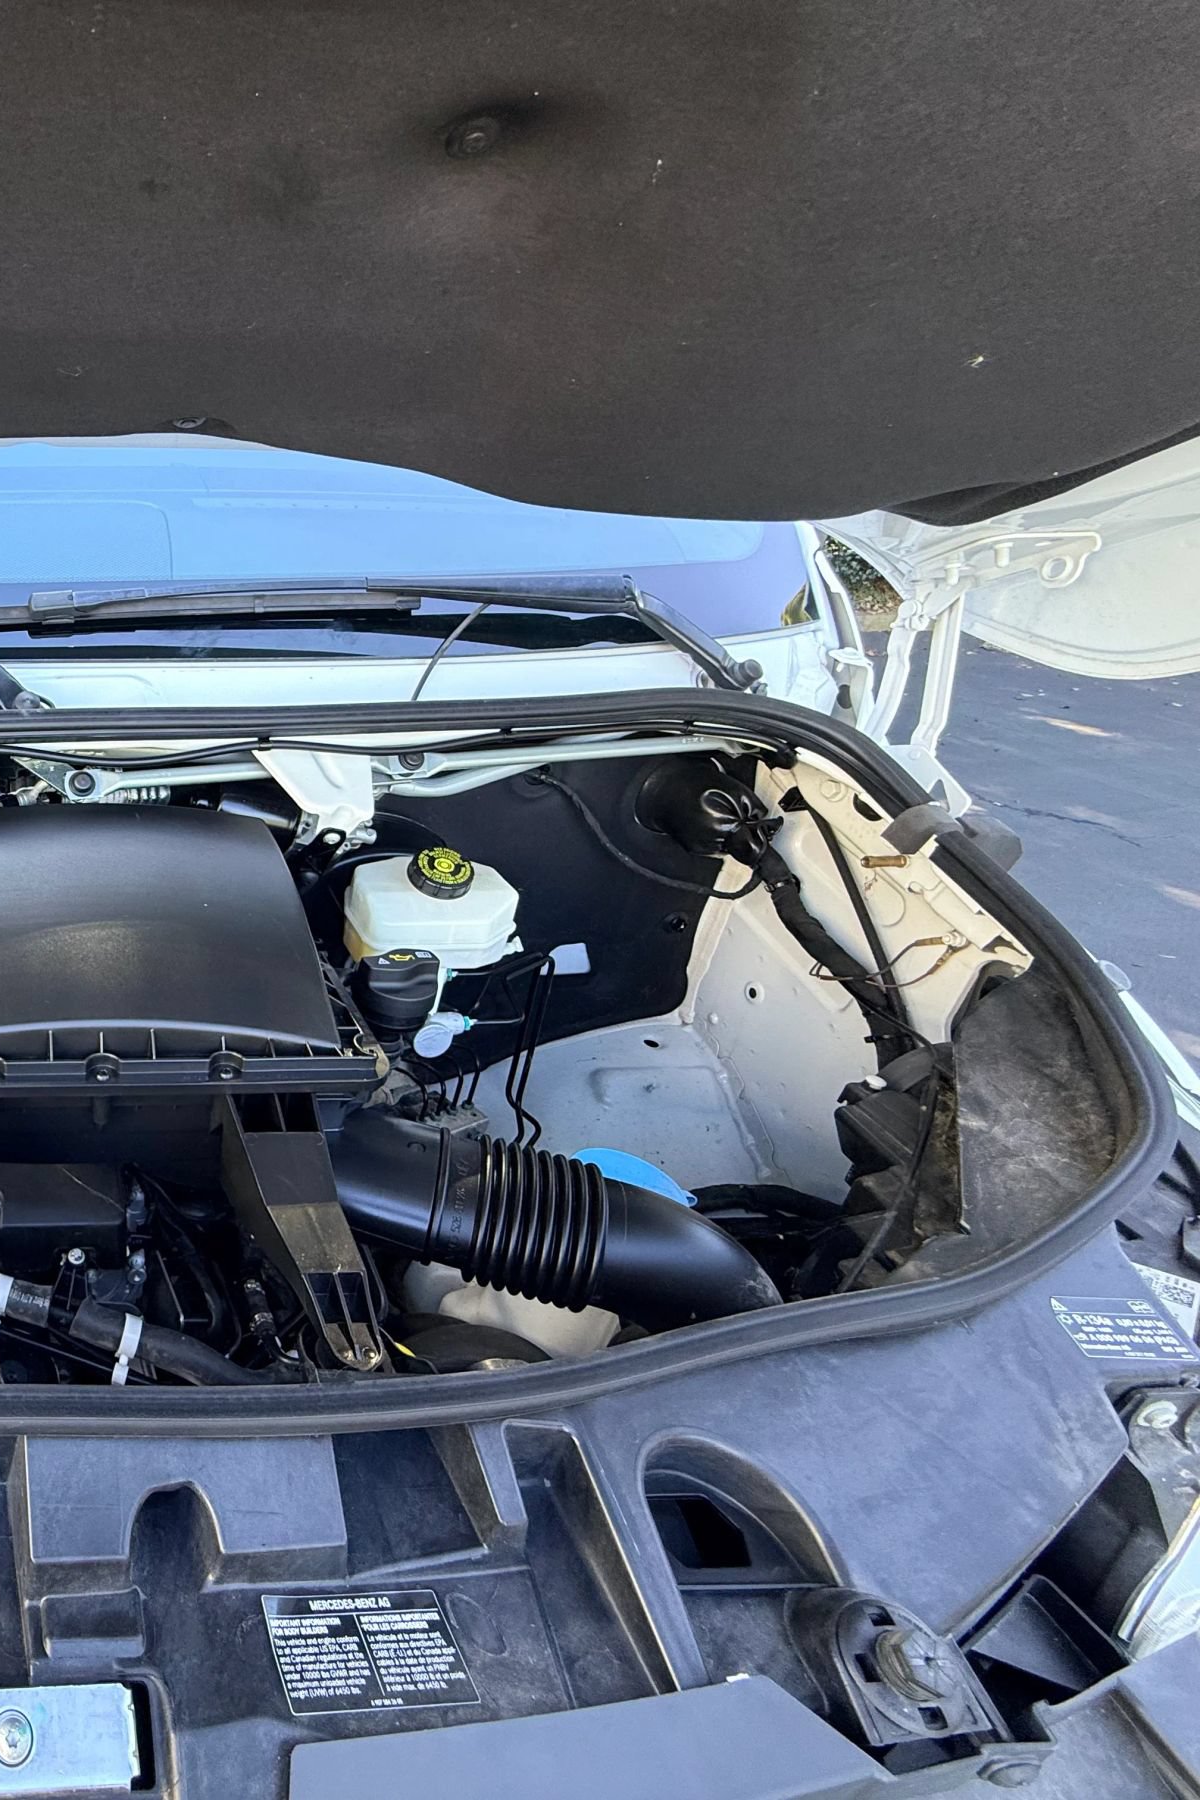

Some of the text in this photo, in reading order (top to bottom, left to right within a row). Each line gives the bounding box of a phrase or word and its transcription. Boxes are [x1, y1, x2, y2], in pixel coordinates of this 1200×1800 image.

[1071, 1313, 1114, 1326] R-134a
[308, 1597, 391, 1610] MERCEDES-BENZ AG
[269, 1617, 340, 1627] IMPORTANT INFORMATION
[362, 1623, 379, 1631] POUR
[284, 1627, 299, 1635] BODY
[300, 1626, 328, 1634] BUILDERS
[317, 1636, 336, 1645] engine
[336, 1635, 359, 1643] conform
[370, 1641, 398, 1649] conformes
[291, 1646, 319, 1654] applicable
[420, 1647, 441, 1655] Canada
[290, 1654, 316, 1662] Canadian
[317, 1652, 347, 1662] regulations
[375, 1658, 394, 1666] cables
[425, 1654, 455, 1663] production
[302, 1662, 336, 1670] manufacture
[410, 1665, 426, 1673] ayant
[284, 1672, 300, 1680] under
[302, 1671, 320, 1679] 10000
[411, 1673, 429, 1681] 10000
[449, 1671, 466, 1679] poids
[291, 1680, 319, 1688] maximum
[320, 1678, 346, 1687] unloaded
[346, 1677, 366, 1685] vehicle
[390, 1683, 402, 1691] vide
[424, 1681, 440, 1689] 6450
[289, 1690, 309, 1699] weight
[334, 1687, 350, 1695] 6450
